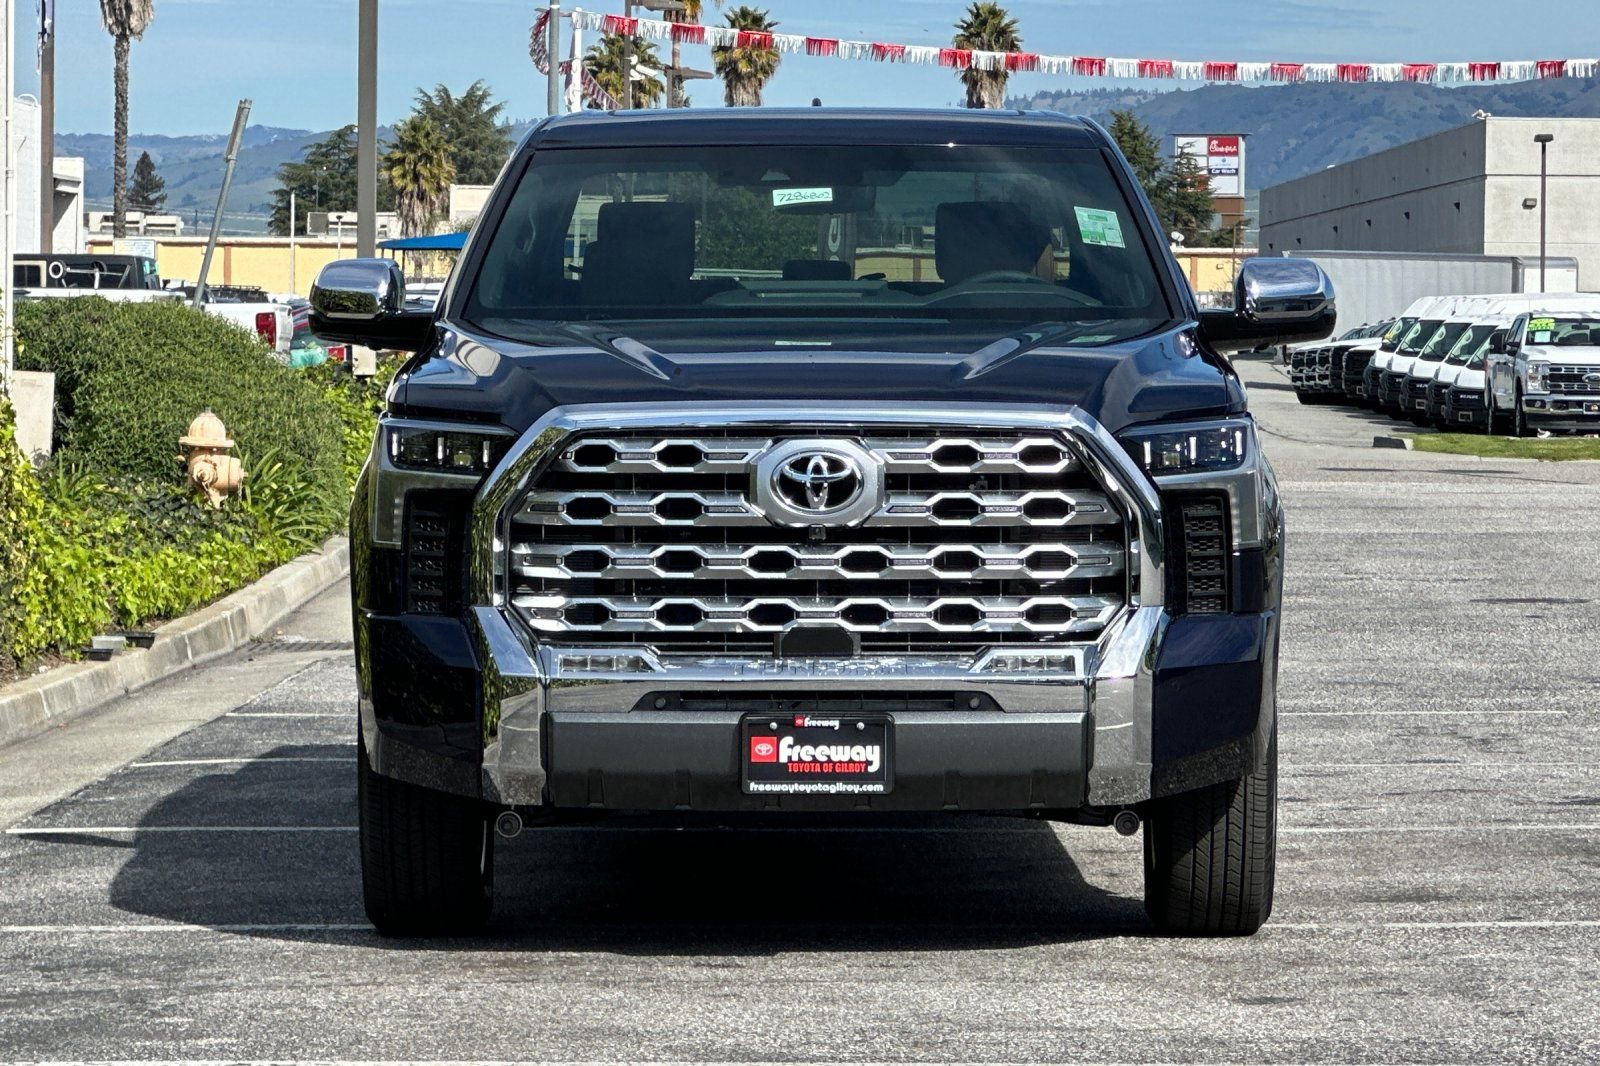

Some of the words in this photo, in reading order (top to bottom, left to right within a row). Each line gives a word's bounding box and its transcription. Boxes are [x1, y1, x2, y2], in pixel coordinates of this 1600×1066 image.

[804, 717, 840, 730] freeway
[779, 736, 880, 773] freeway
[788, 763, 820, 773] TOYOTA
[823, 763, 833, 773] OF
[835, 763, 866, 773] GILROY
[749, 782, 884, 793] freewaytoyotagilroy.com
